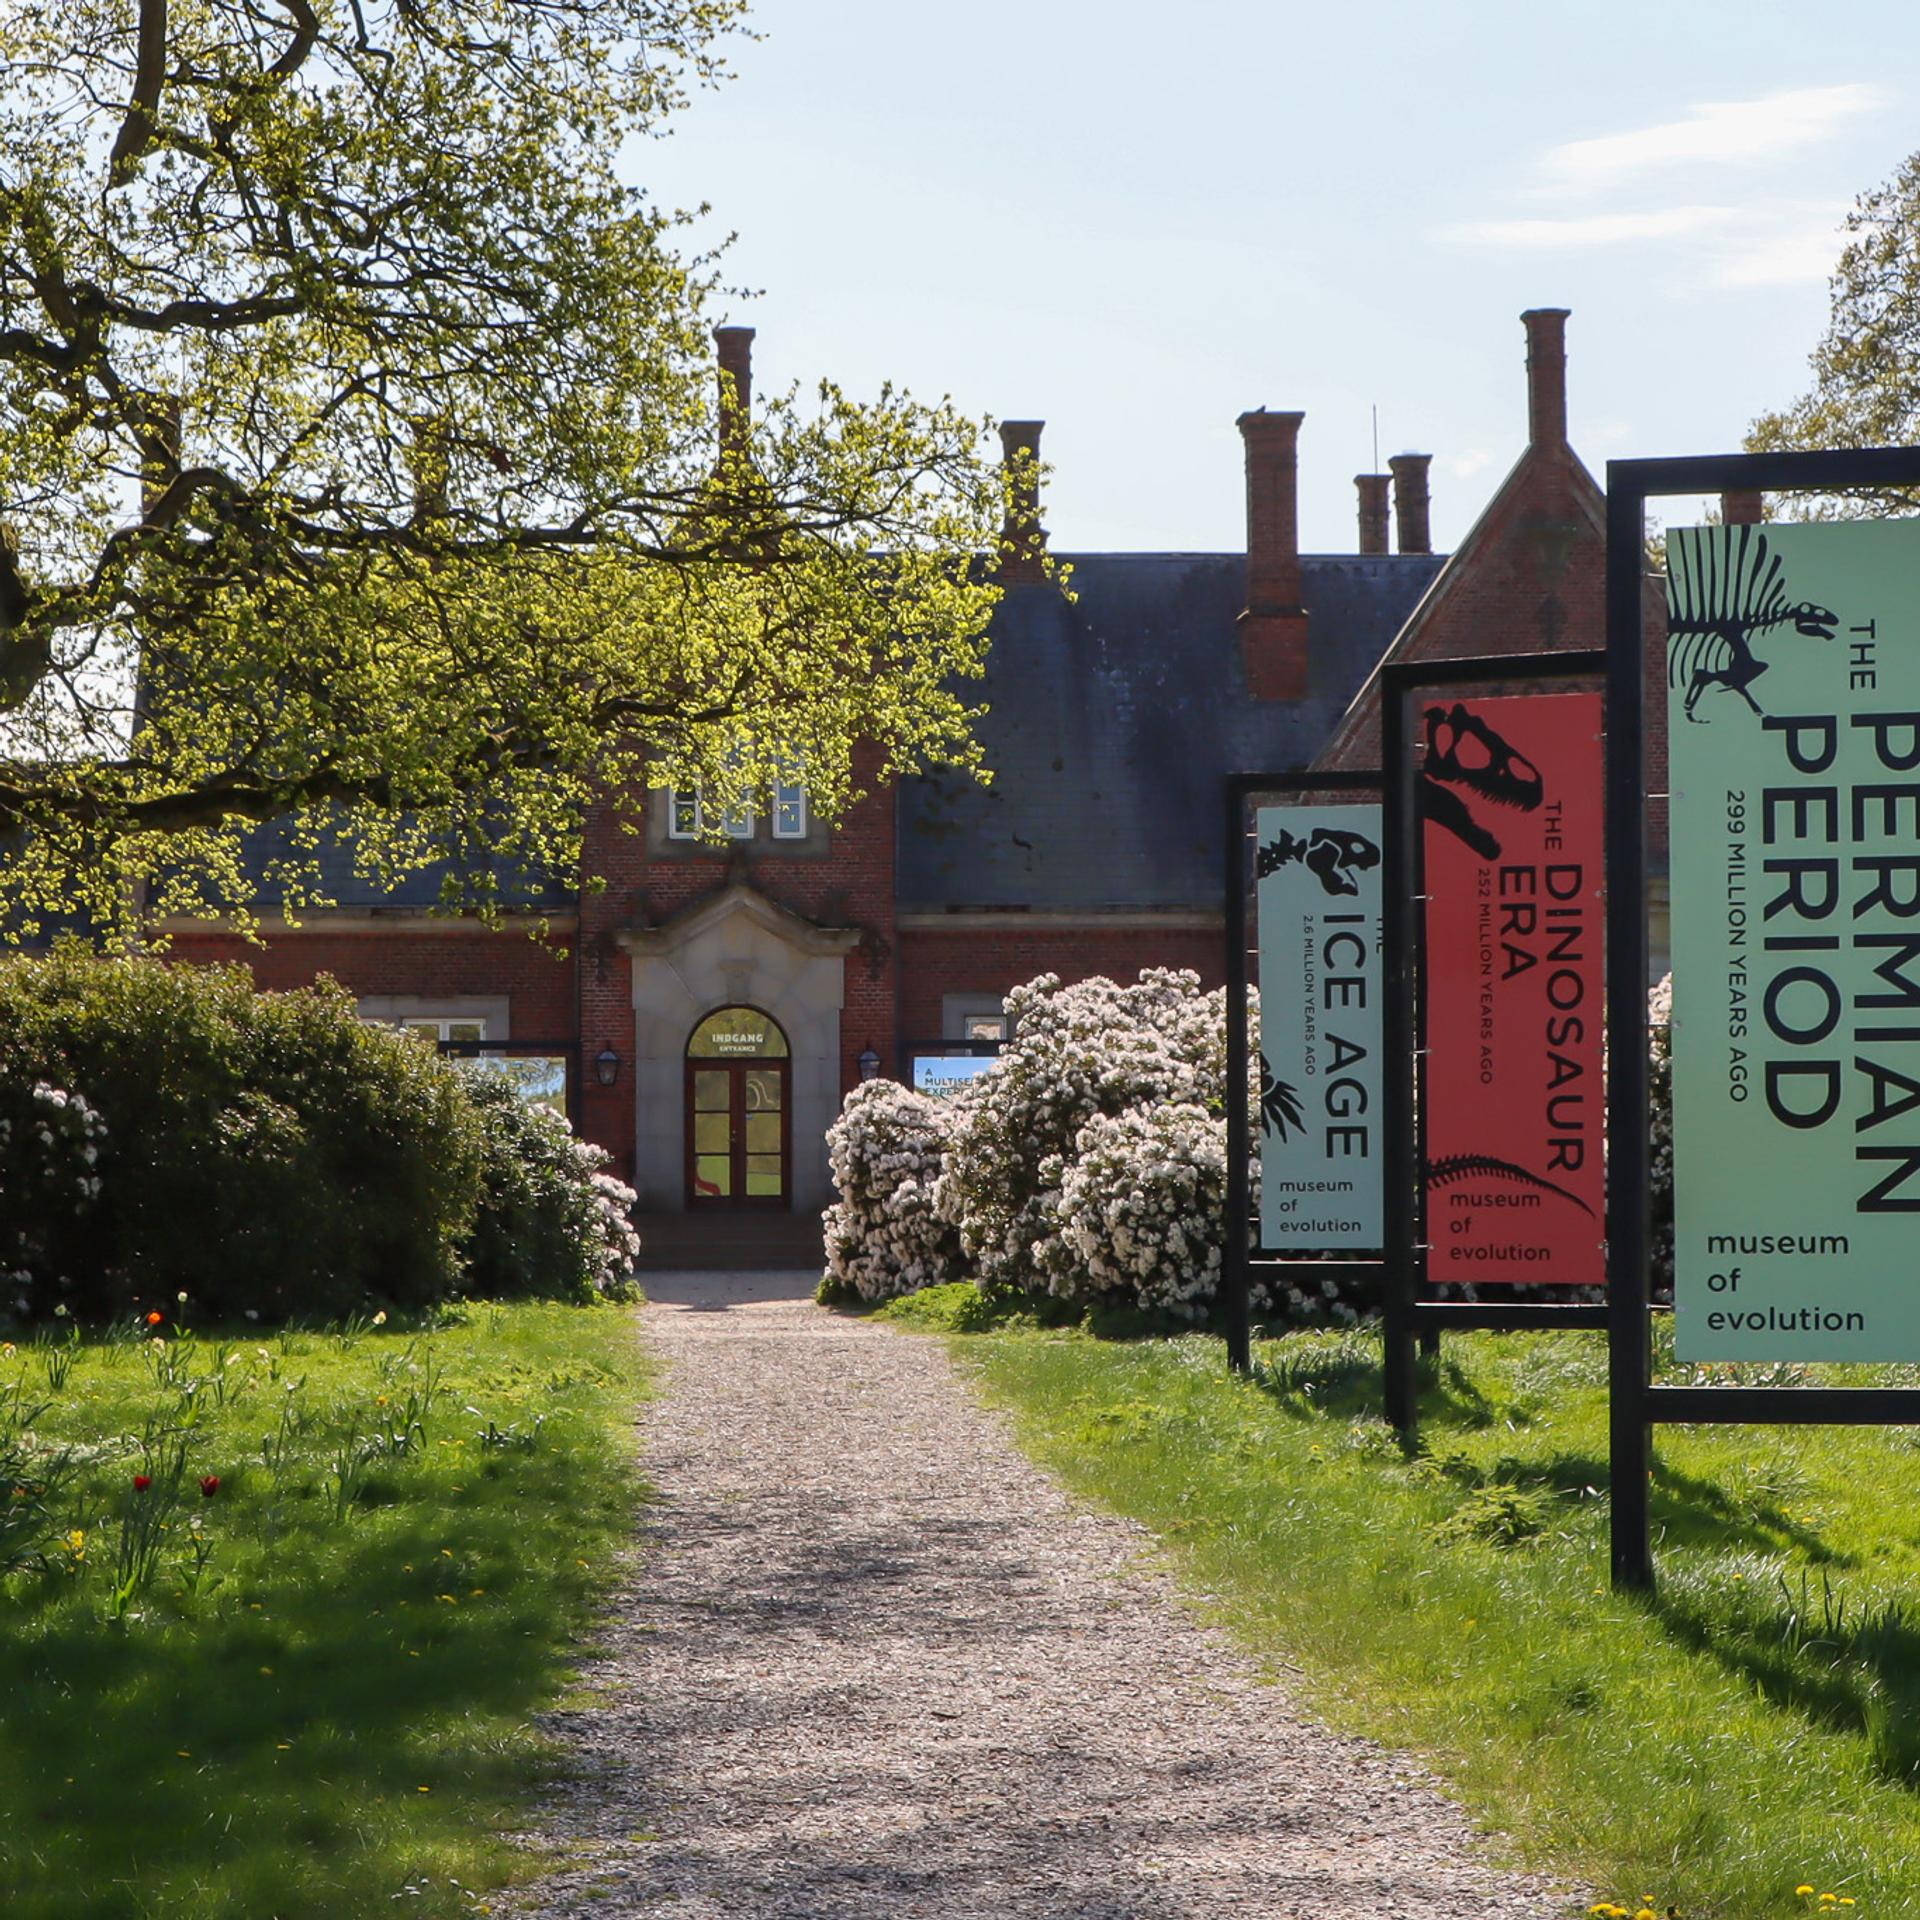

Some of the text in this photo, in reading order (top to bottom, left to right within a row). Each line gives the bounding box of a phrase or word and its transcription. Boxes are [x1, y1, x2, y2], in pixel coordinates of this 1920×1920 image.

[1500, 866, 1538, 980] ERA
[1762, 715, 1841, 1129] PERIOD
[1850, 619, 1920, 1213] THE PERMIAN
[1727, 790, 1747, 1102] 299 MILLION YEARS AGO
[1479, 868, 1492, 1084] 252 MILLION YEARS AGO
[1545, 801, 1584, 1172] THE DINOSAUR
[1304, 915, 1315, 1075] 2.6 MILLION YEARS AGO
[712, 1033, 764, 1043] INDGANG
[1323, 915, 1368, 1158] ICE AGE
[925, 1067, 933, 1076] A
[1280, 1181, 1353, 1192] museum
[1280, 1199, 1297, 1212] of
[1450, 1194, 1540, 1207] museum
[1280, 1220, 1361, 1232] evolution
[1450, 1217, 1471, 1233] of
[1450, 1243, 1550, 1260] evolution
[1708, 1236, 1848, 1254] museum
[1708, 1268, 1741, 1292] of
[1708, 1307, 1863, 1330] evolution
